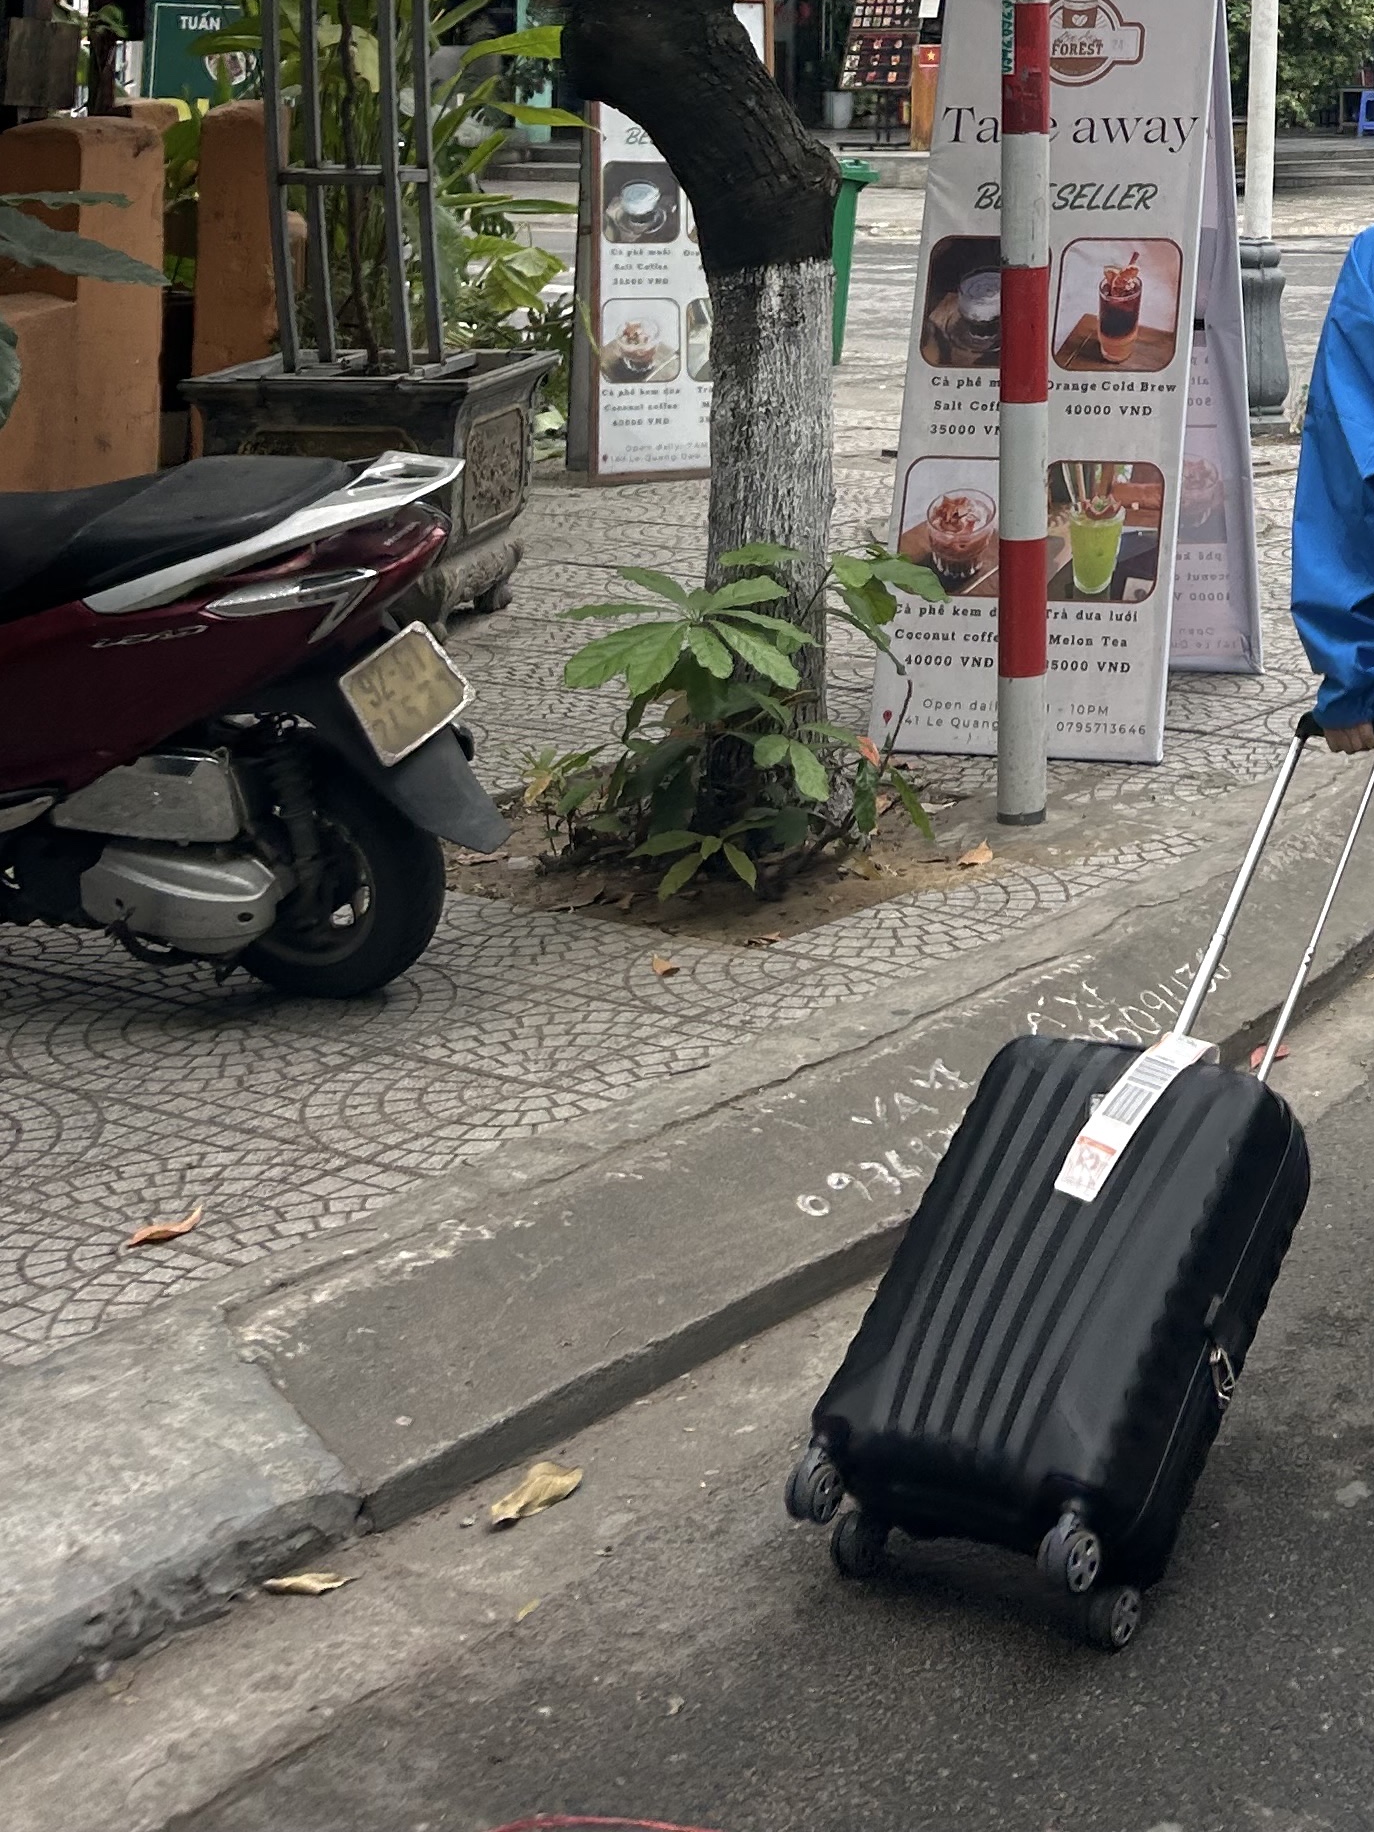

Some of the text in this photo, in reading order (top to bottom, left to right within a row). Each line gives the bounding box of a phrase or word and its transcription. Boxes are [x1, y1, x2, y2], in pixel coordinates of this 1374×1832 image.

[180, 11, 221, 31] TUẤN
[1051, 40, 1104, 56] FOREST
[1072, 116, 1200, 154] away
[1052, 182, 1159, 211] SELLER
[956, 375, 982, 389] phê
[1101, 380, 1135, 392] Cold
[1140, 382, 1177, 393] Brew
[933, 400, 963, 411] Salt
[1065, 404, 1152, 416] 40000 VND
[929, 424, 976, 435] 35000
[919, 603, 945, 617] phê
[952, 605, 983, 617] kem
[895, 628, 956, 641] Coconut
[1049, 634, 1128, 647] Melon Tea
[904, 655, 994, 668] 40000 VND
[1096, 661, 1131, 673] VND
[922, 698, 962, 710] Open
[1070, 703, 1109, 715] 10PM
[926, 715, 944, 727] Le
[1056, 721, 1147, 736] 0795713646
